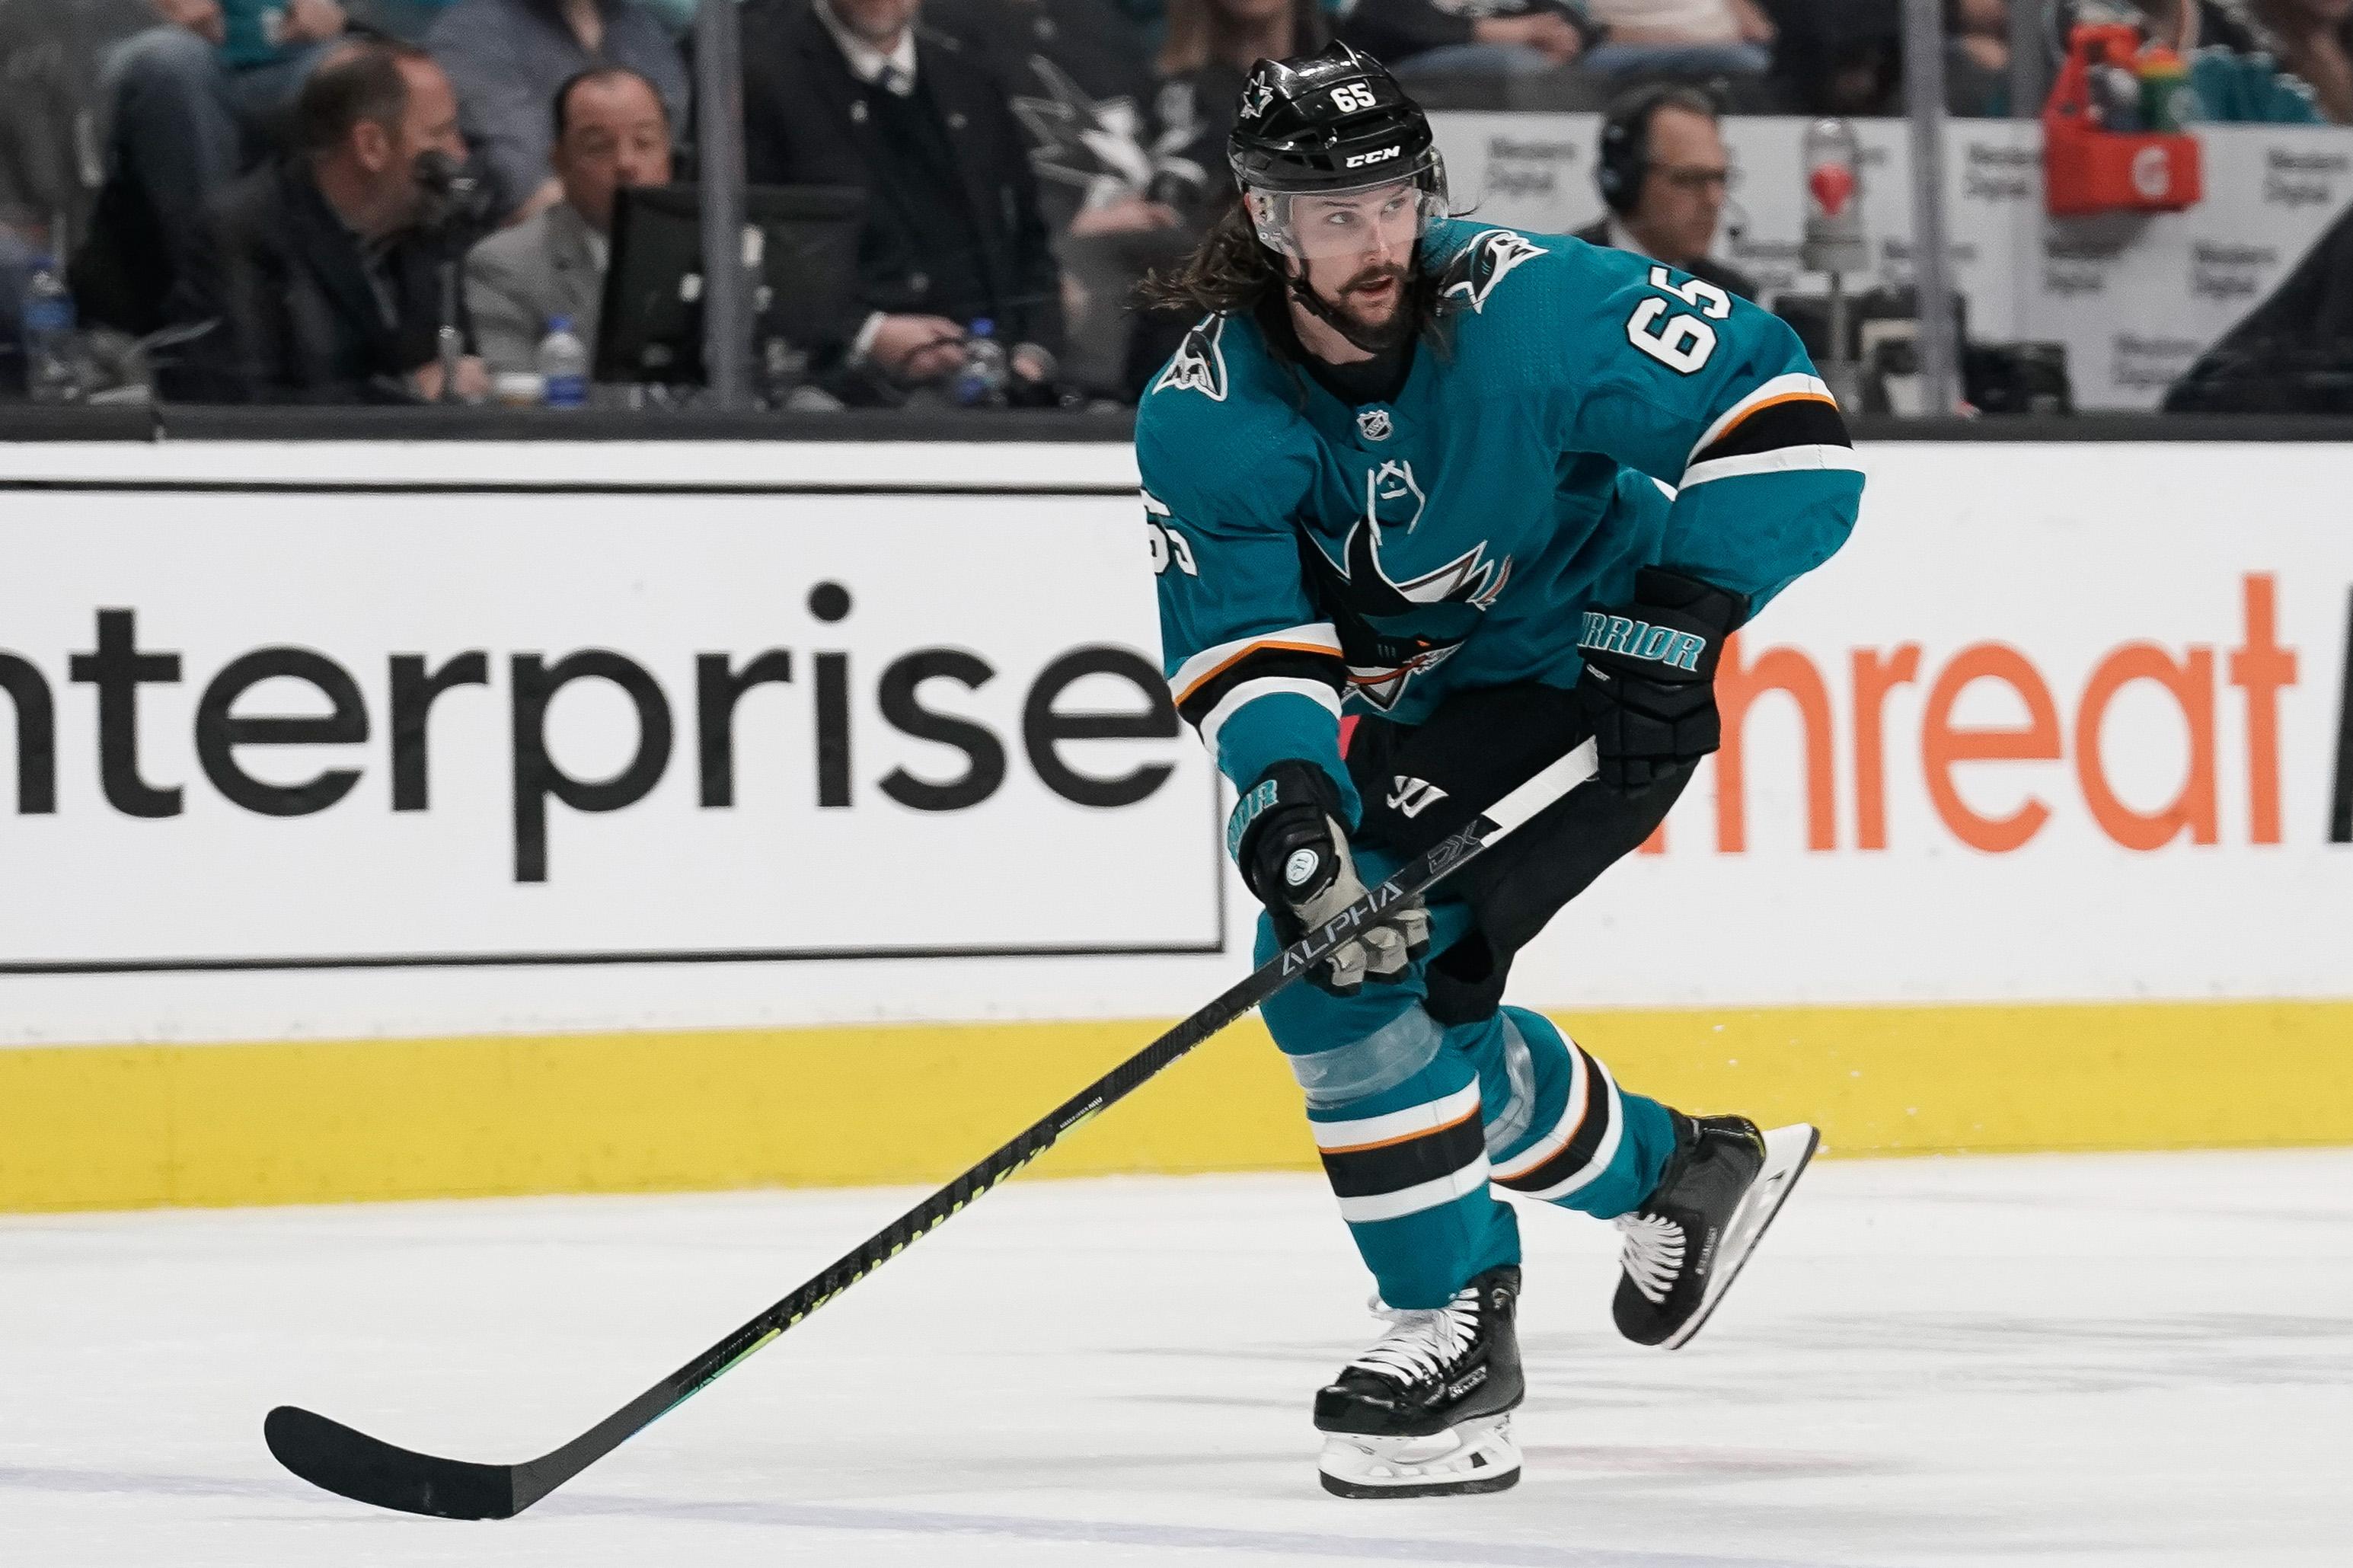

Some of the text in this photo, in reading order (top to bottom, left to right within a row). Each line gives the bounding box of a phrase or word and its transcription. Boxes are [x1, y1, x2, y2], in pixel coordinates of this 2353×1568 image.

[1330, 82, 1377, 113] 65
[1346, 145, 1400, 168] CCM
[1625, 265, 1732, 376] 65
[1636, 571, 2299, 855] hreat
[1283, 881, 1403, 976] ALPHA
